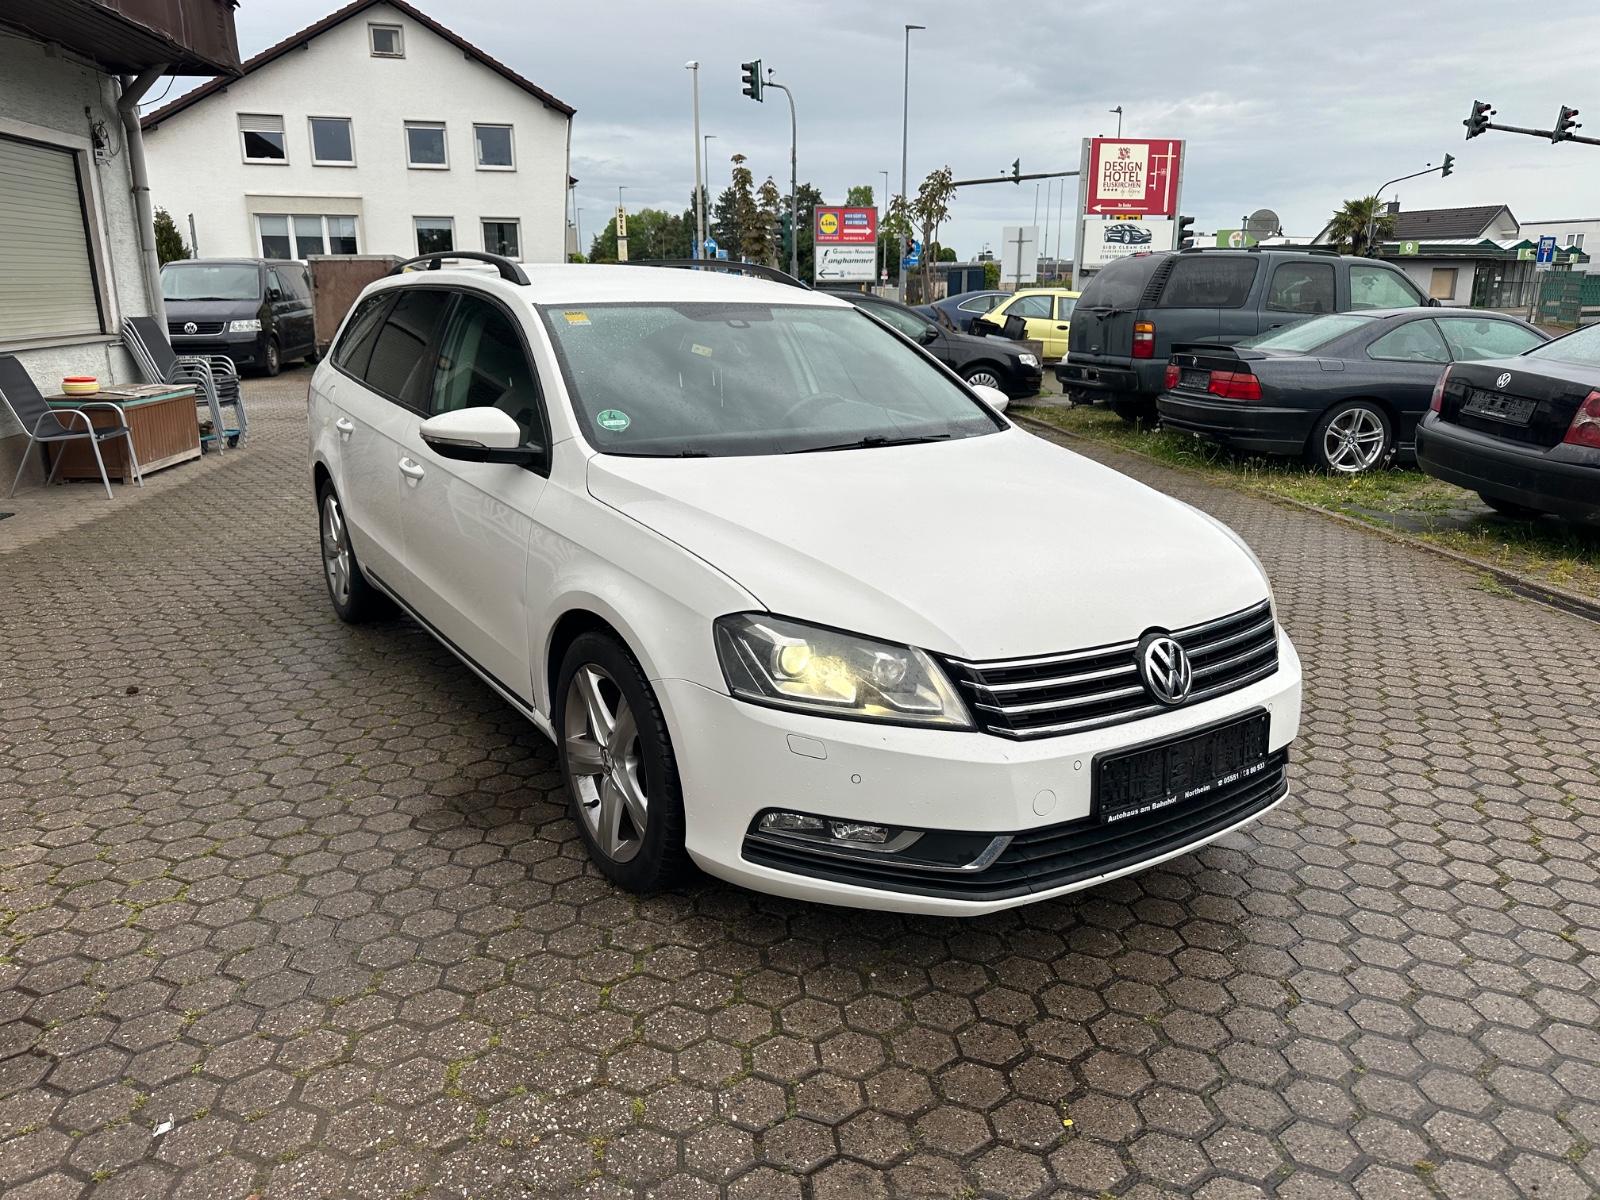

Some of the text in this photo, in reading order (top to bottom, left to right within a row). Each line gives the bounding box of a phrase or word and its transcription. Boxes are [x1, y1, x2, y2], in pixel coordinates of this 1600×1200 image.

[1104, 161, 1143, 172] DESIGN
[1103, 172, 1141, 182] HOTEL
[1102, 181, 1141, 189] EUSKIRCHEN
[1107, 808, 1139, 823] Autohaus
[1139, 804, 1151, 813] am
[1151, 795, 1177, 810] Bahnhof
[1184, 784, 1211, 799] Northeim
